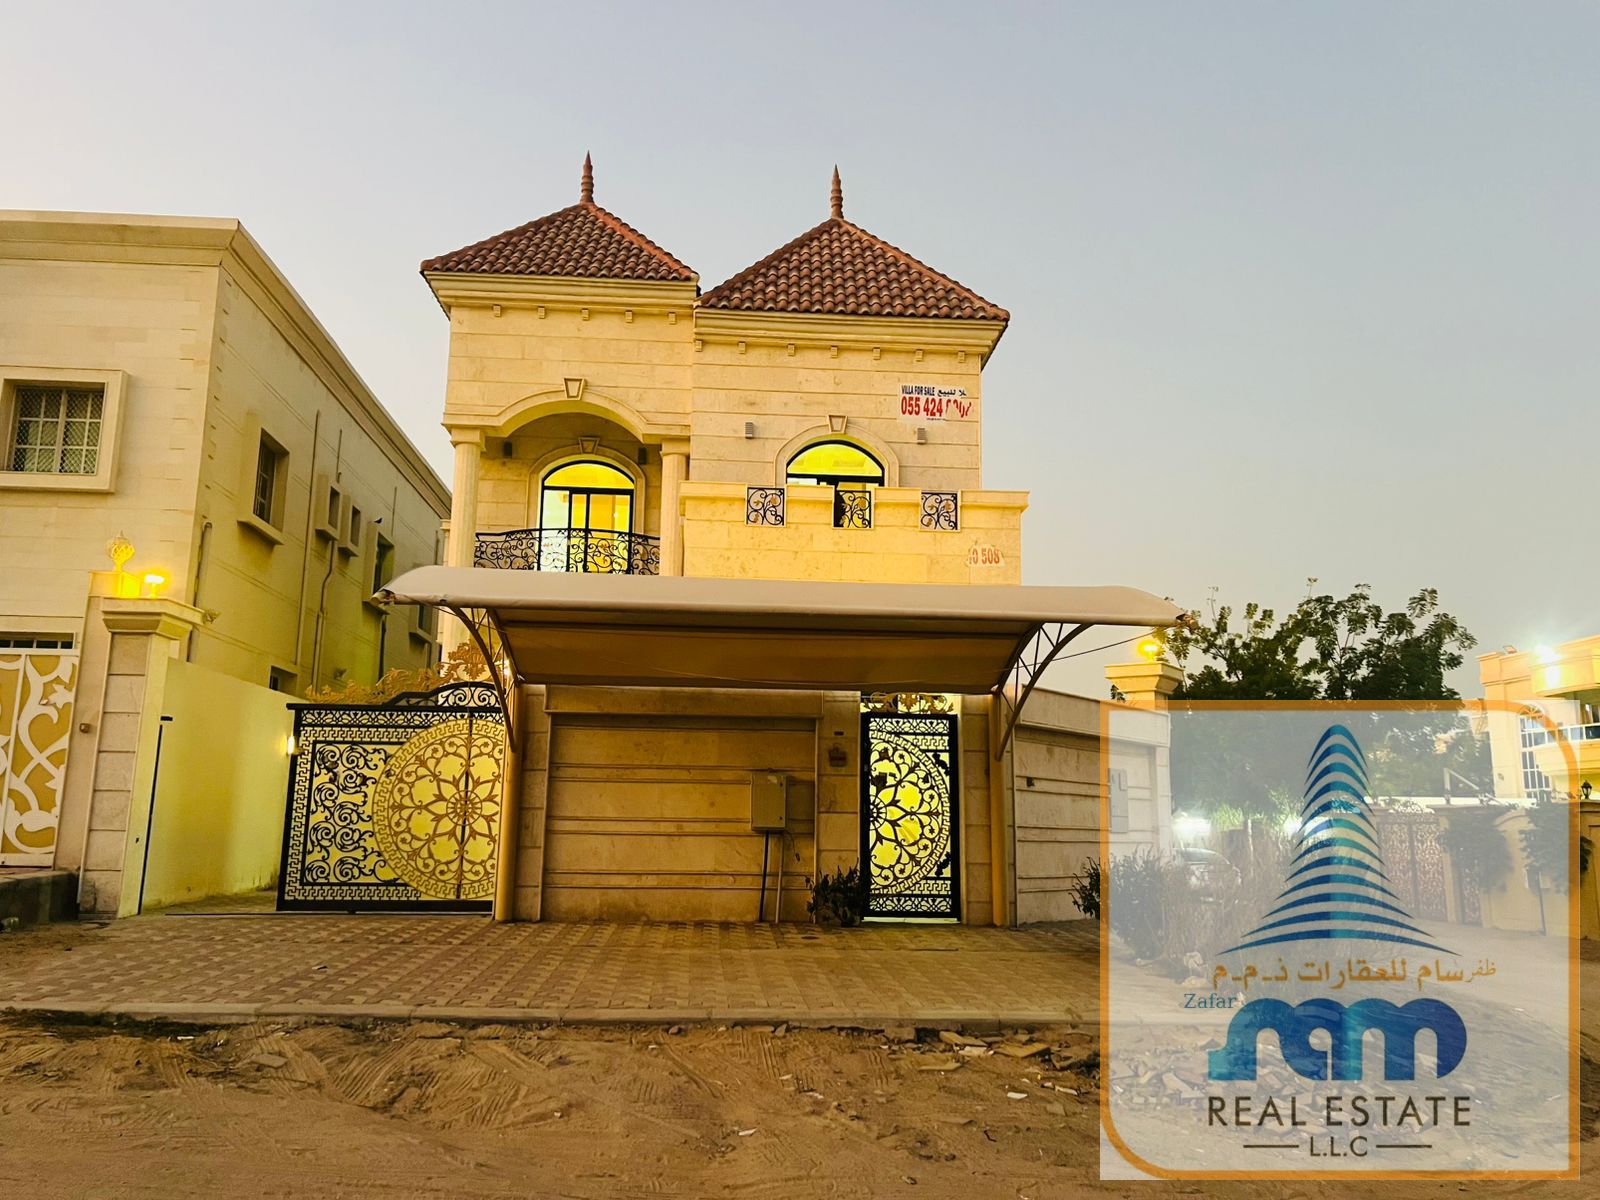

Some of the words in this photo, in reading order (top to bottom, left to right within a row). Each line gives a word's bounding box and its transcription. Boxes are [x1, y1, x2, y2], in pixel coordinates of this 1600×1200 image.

[901, 385, 914, 395] VILLA
[915, 386, 924, 396] FOR
[924, 387, 935, 397] SALE
[901, 396, 920, 416] 055
[923, 397, 943, 417] 424
[981, 547, 1000, 565] 508
